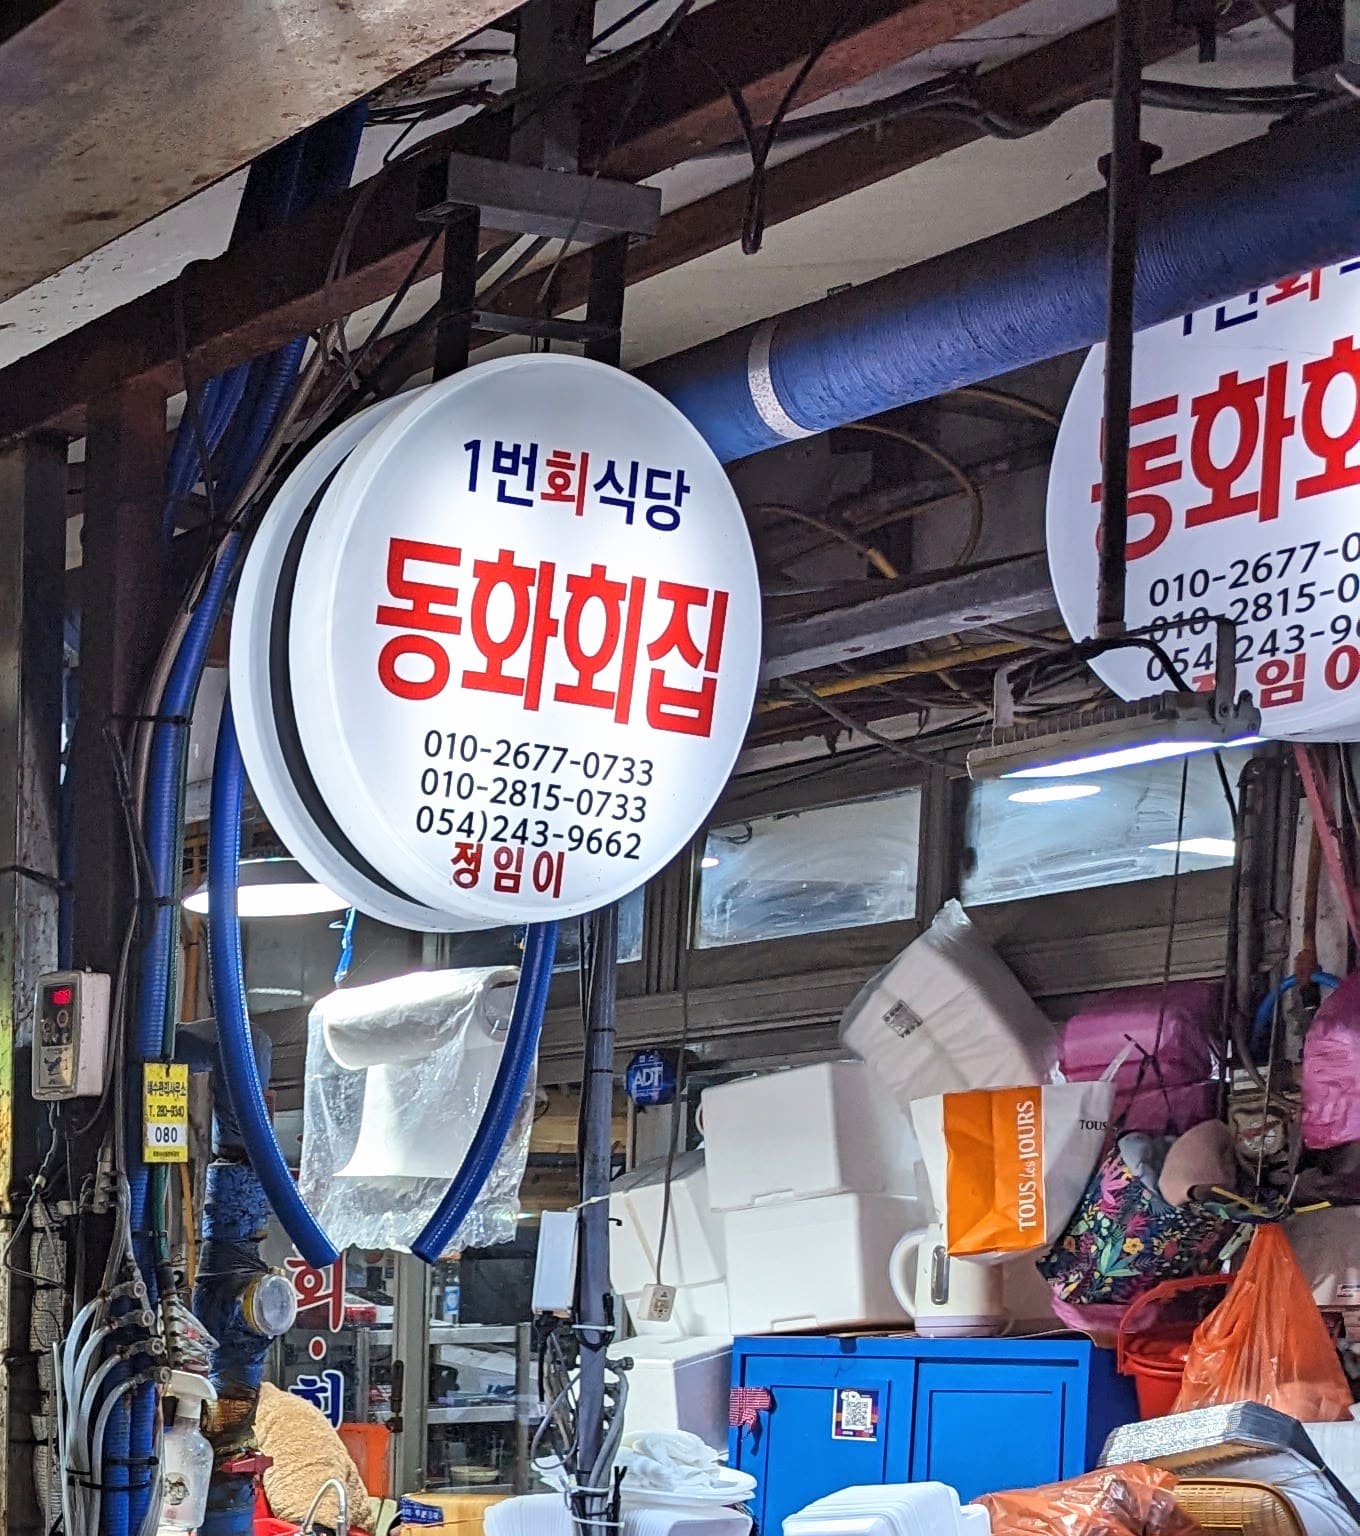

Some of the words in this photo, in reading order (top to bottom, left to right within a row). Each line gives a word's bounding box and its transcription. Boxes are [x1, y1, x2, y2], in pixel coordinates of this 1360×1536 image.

[463, 439, 691, 532] 1번회식당
[376, 537, 729, 739] 동화회집
[423, 730, 655, 787] 010-2677-0733
[420, 767, 647, 823] 010-2815-0733
[415, 806, 643, 859] 054)243-9662
[632, 1066, 663, 1088] ADT
[154, 1126, 178, 1143] 080
[1017, 1100, 1040, 1159] JOURS
[1018, 1181, 1037, 1233] TOUS
